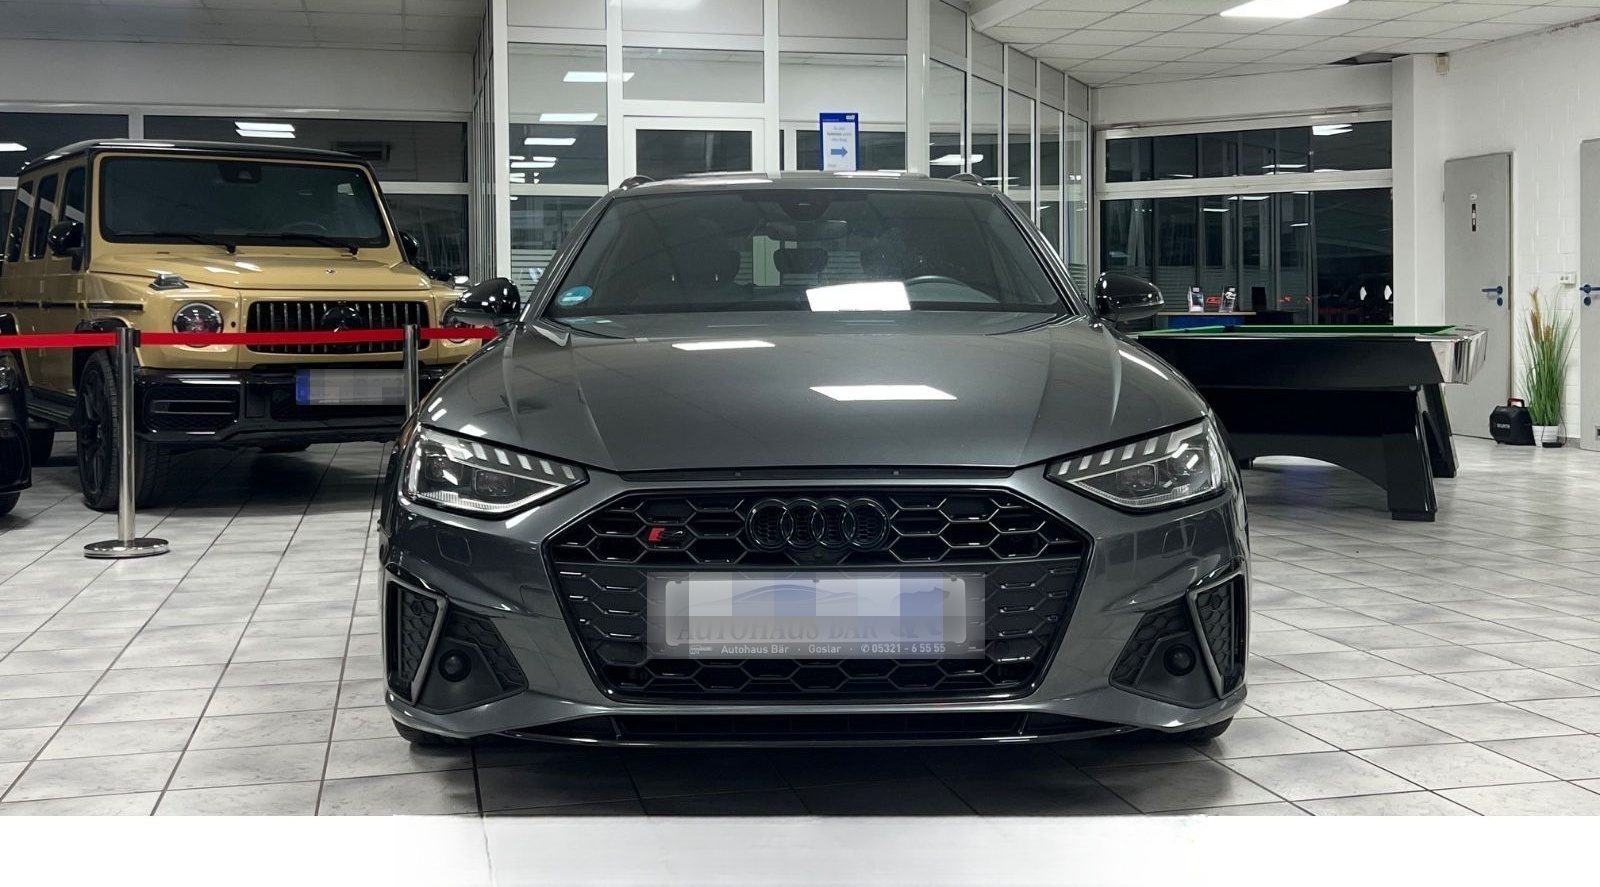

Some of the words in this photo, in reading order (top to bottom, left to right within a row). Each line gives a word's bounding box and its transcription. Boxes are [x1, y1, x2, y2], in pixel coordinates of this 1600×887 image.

[677, 616, 818, 640] AUTOHAUS
[721, 644, 769, 654] Autohaus
[771, 644, 790, 654] Bär
[808, 643, 842, 653] Goslar
[871, 643, 901, 653] 05321
[911, 643, 918, 653] 6
